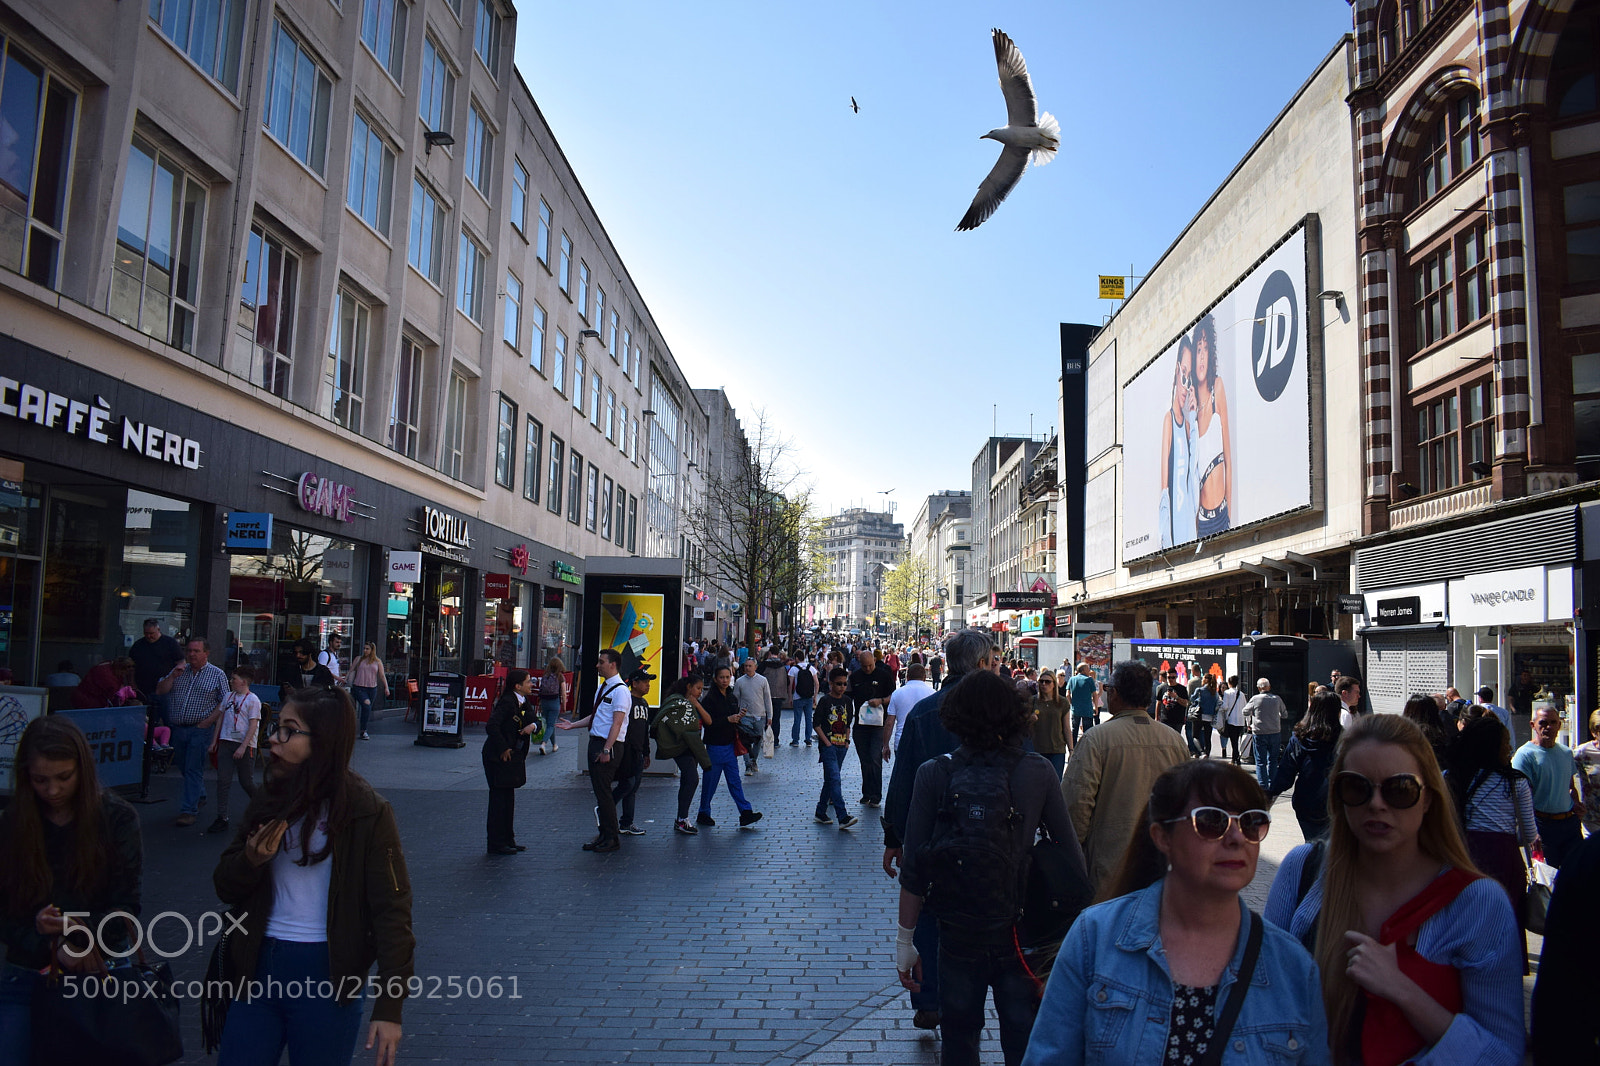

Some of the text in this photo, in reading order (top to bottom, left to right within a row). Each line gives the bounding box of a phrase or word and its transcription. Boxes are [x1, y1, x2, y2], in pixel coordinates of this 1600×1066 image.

[1257, 296, 1292, 377] JD
[122, 415, 200, 470] NERO
[298, 471, 356, 524] GAME
[229, 530, 266, 539] NERO
[425, 505, 470, 548] TORTILLA
[392, 563, 416, 571] GAME
[1379, 608, 1396, 617] Warren
[1397, 606, 1413, 616] James
[1471, 588, 1535, 607] YANKEE CANDLE
